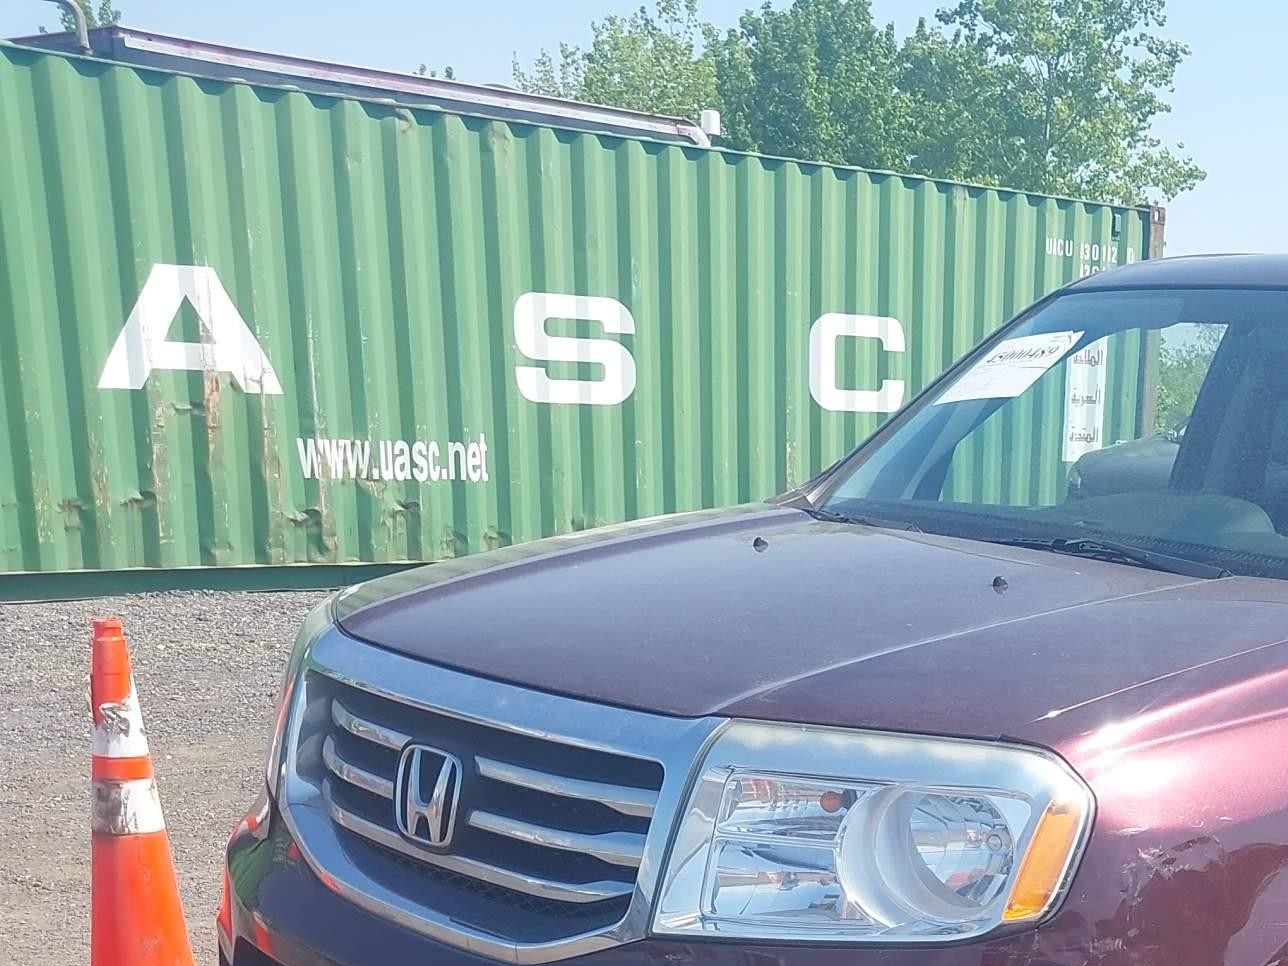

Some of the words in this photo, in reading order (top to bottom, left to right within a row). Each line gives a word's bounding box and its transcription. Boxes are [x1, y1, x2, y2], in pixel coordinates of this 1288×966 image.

[97, 263, 283, 395] A
[513, 291, 637, 405] S
[808, 312, 906, 413] C
[296, 432, 489, 482] www.uasc.net
